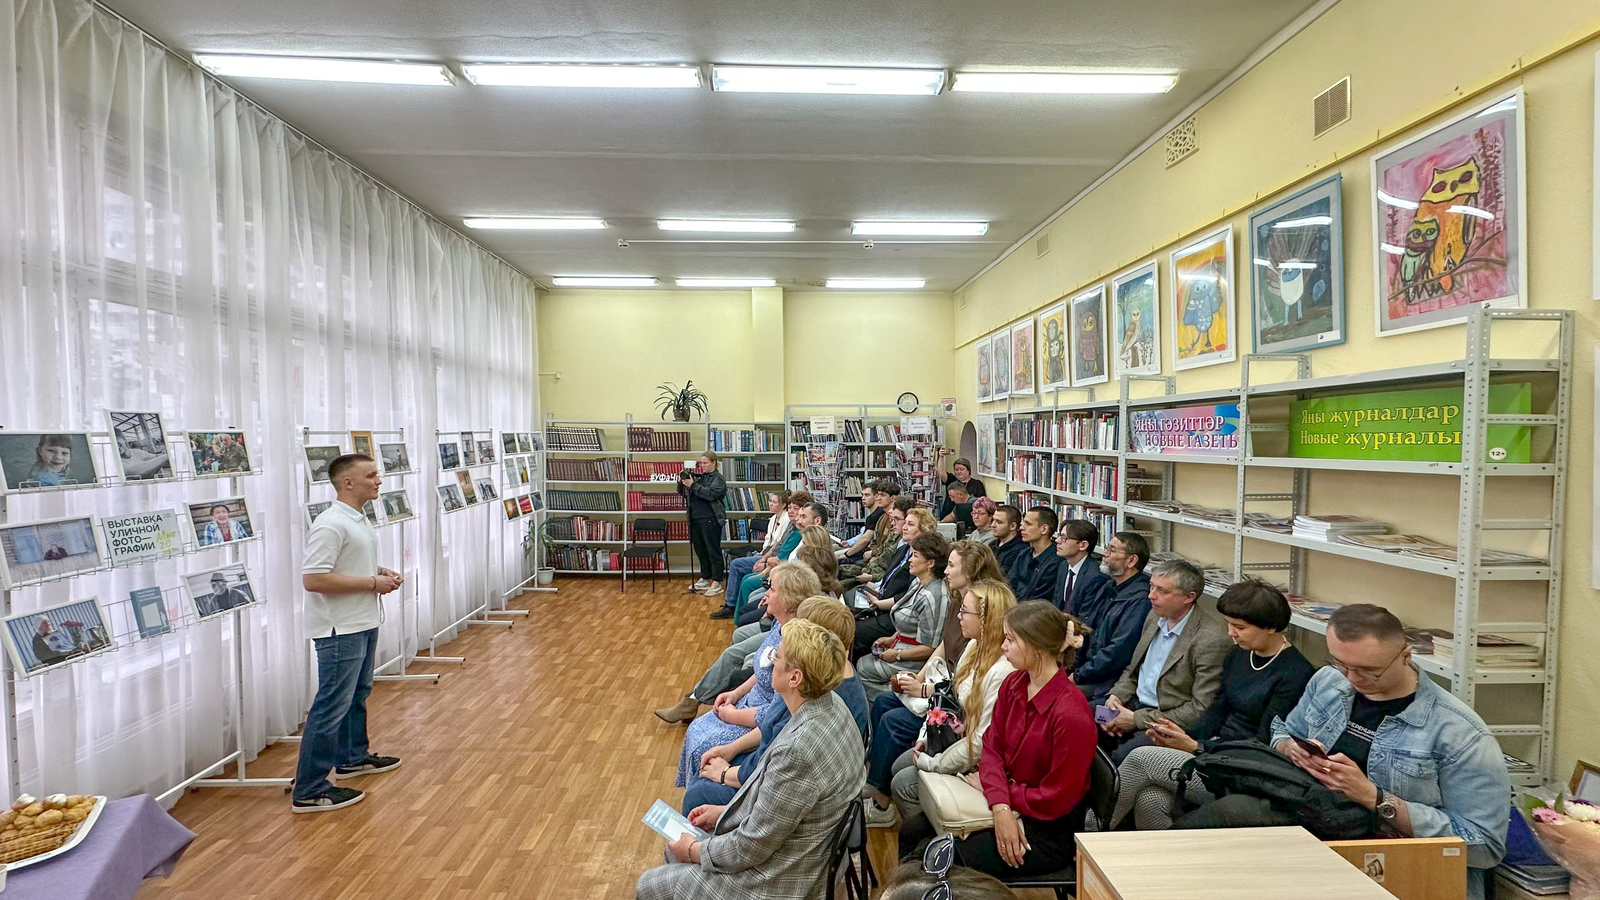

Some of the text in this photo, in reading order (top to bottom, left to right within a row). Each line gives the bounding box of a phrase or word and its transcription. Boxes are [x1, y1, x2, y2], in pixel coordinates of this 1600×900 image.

[1160, 415, 1225, 432] ГӘЗИТТӘР
[1301, 405, 1460, 427] Яңы журналдар
[1145, 433, 1185, 449] НОВЫЕ
[1300, 429, 1463, 450] Новые журналы
[107, 514, 163, 529] ВЫСТАВКА
[109, 522, 160, 539] УЛИЧНОЙ
[114, 542, 156, 556] ГРАФИИ
[159, 540, 171, 550] 20
